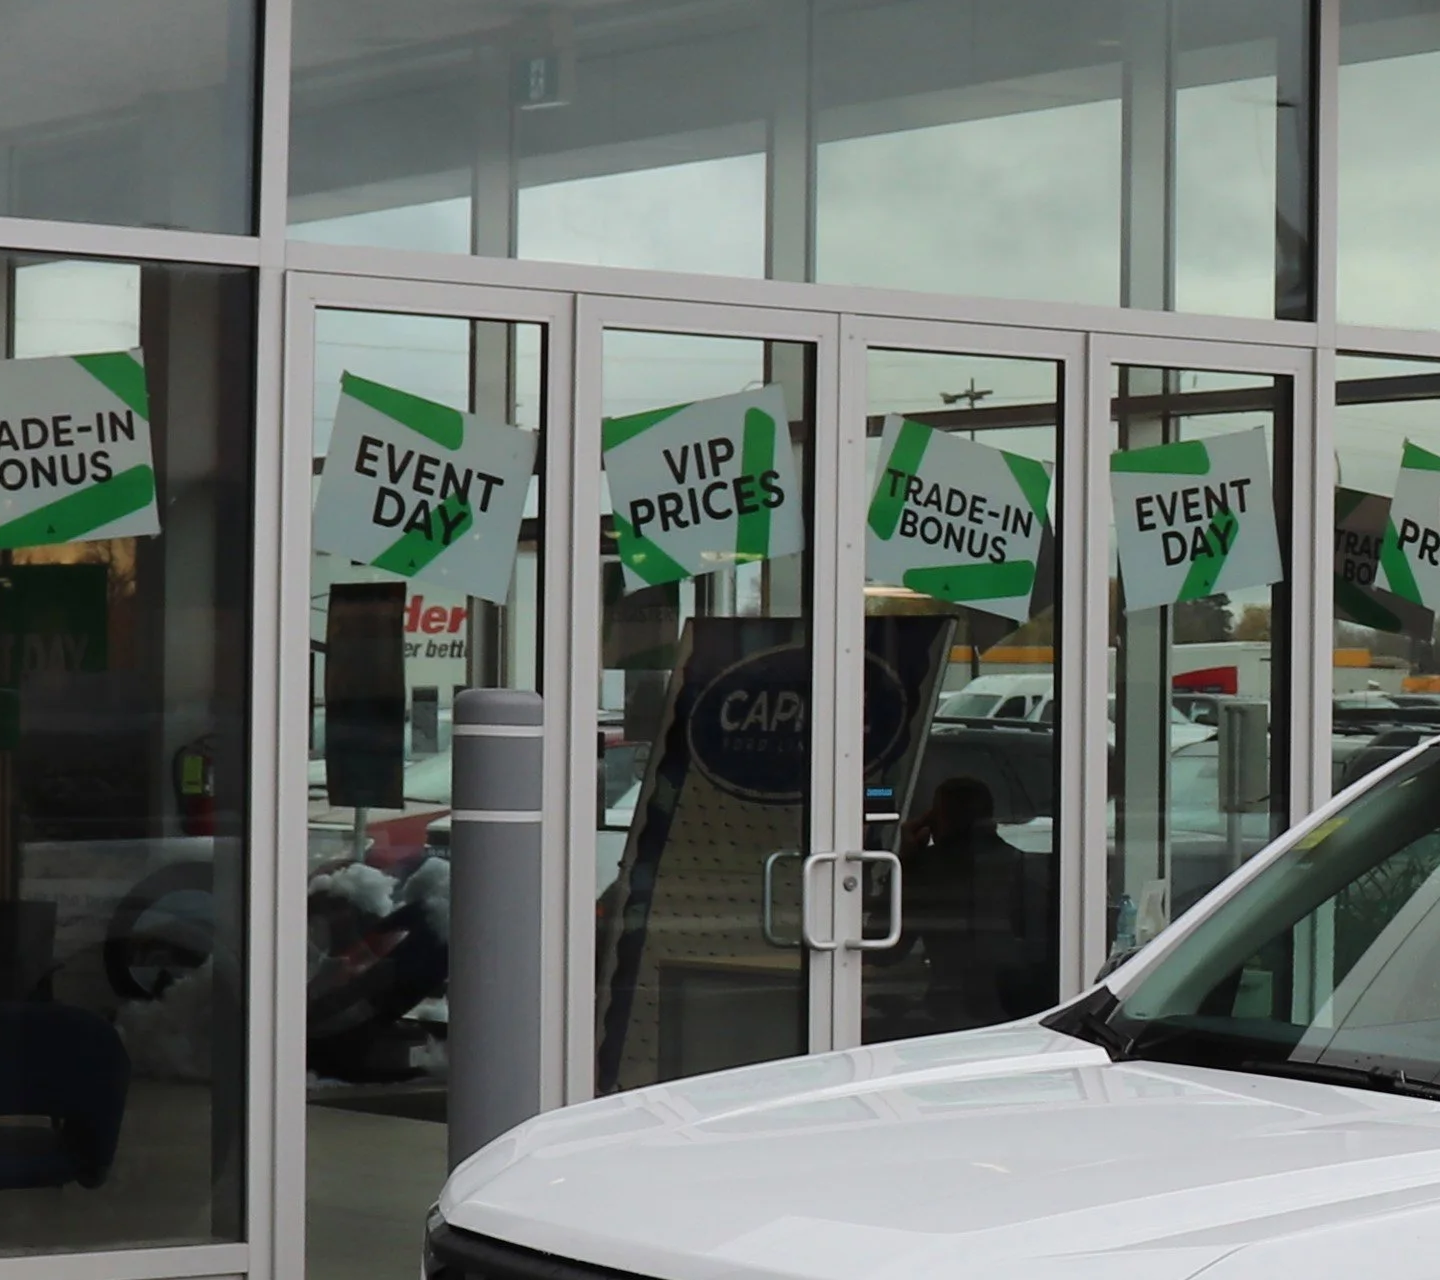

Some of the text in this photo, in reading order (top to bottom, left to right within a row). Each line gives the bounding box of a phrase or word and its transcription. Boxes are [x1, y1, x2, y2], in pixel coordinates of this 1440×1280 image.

[355, 435, 504, 513] EVENT
[662, 437, 735, 485] VIP
[372, 486, 473, 546] DAY
[629, 470, 785, 539] PRICES
[887, 468, 1034, 539] TRADE-IN
[1135, 478, 1252, 534] EVENT
[899, 509, 1008, 565] BONUS
[1161, 521, 1236, 568] DAY
